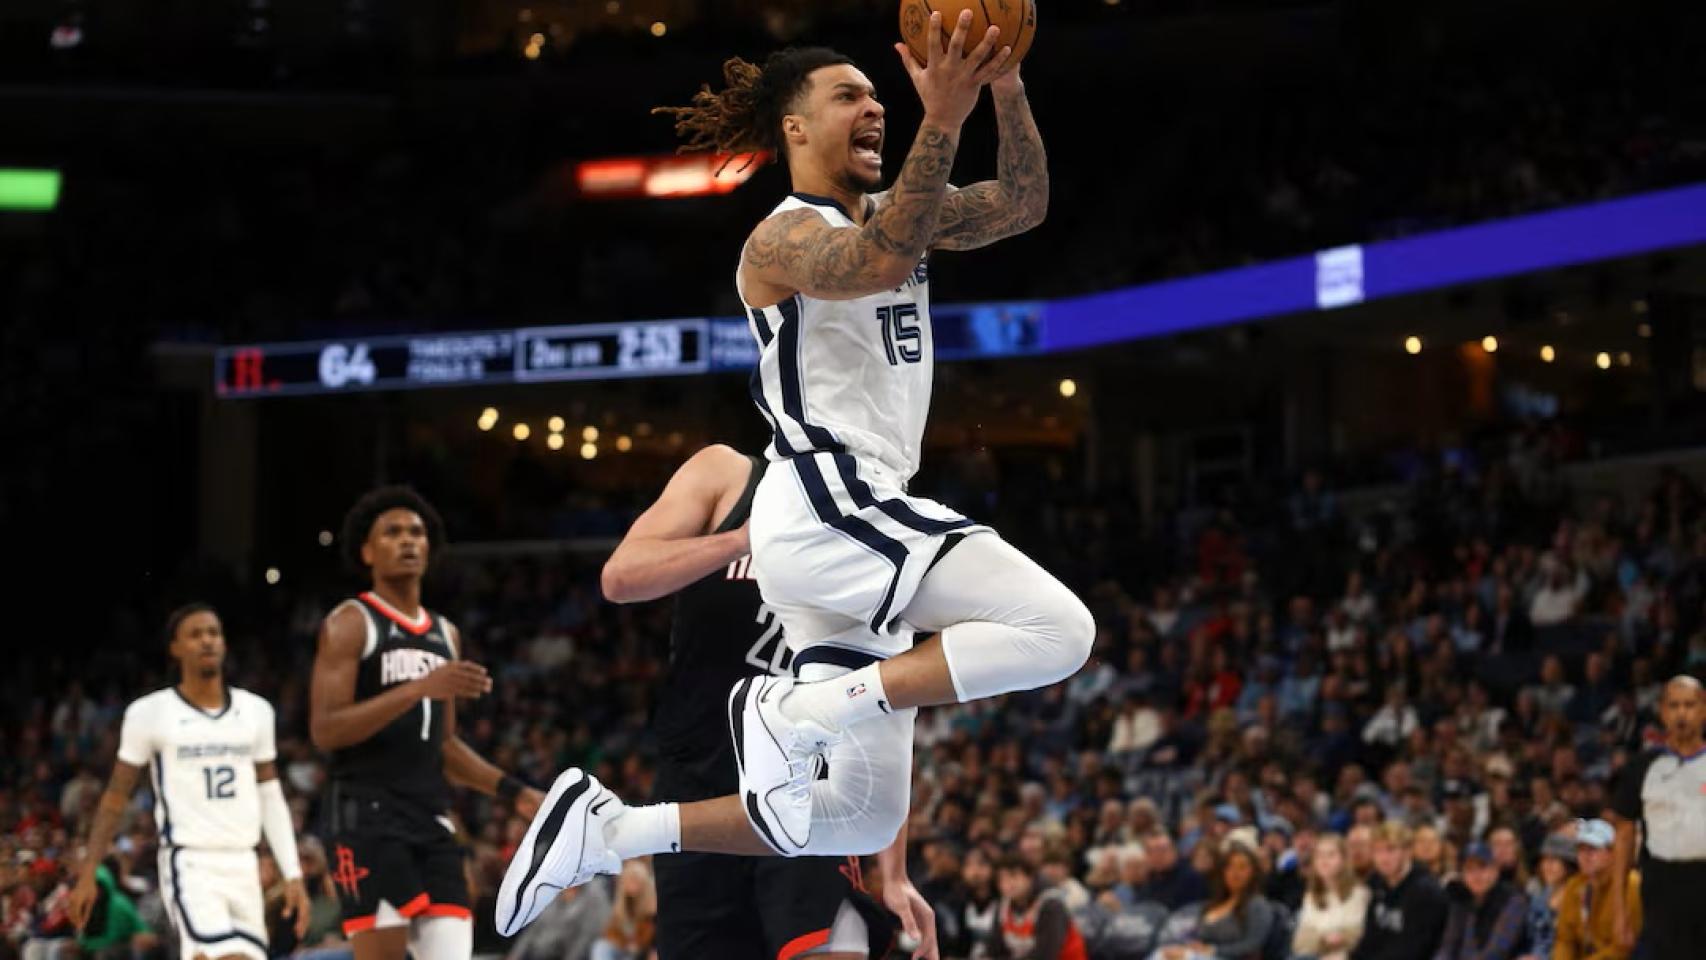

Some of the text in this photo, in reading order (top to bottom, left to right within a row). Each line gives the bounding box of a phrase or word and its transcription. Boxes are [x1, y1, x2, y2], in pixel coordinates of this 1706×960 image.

[876, 303, 921, 365] 15
[319, 343, 377, 388] 64
[203, 766, 235, 800] 12
